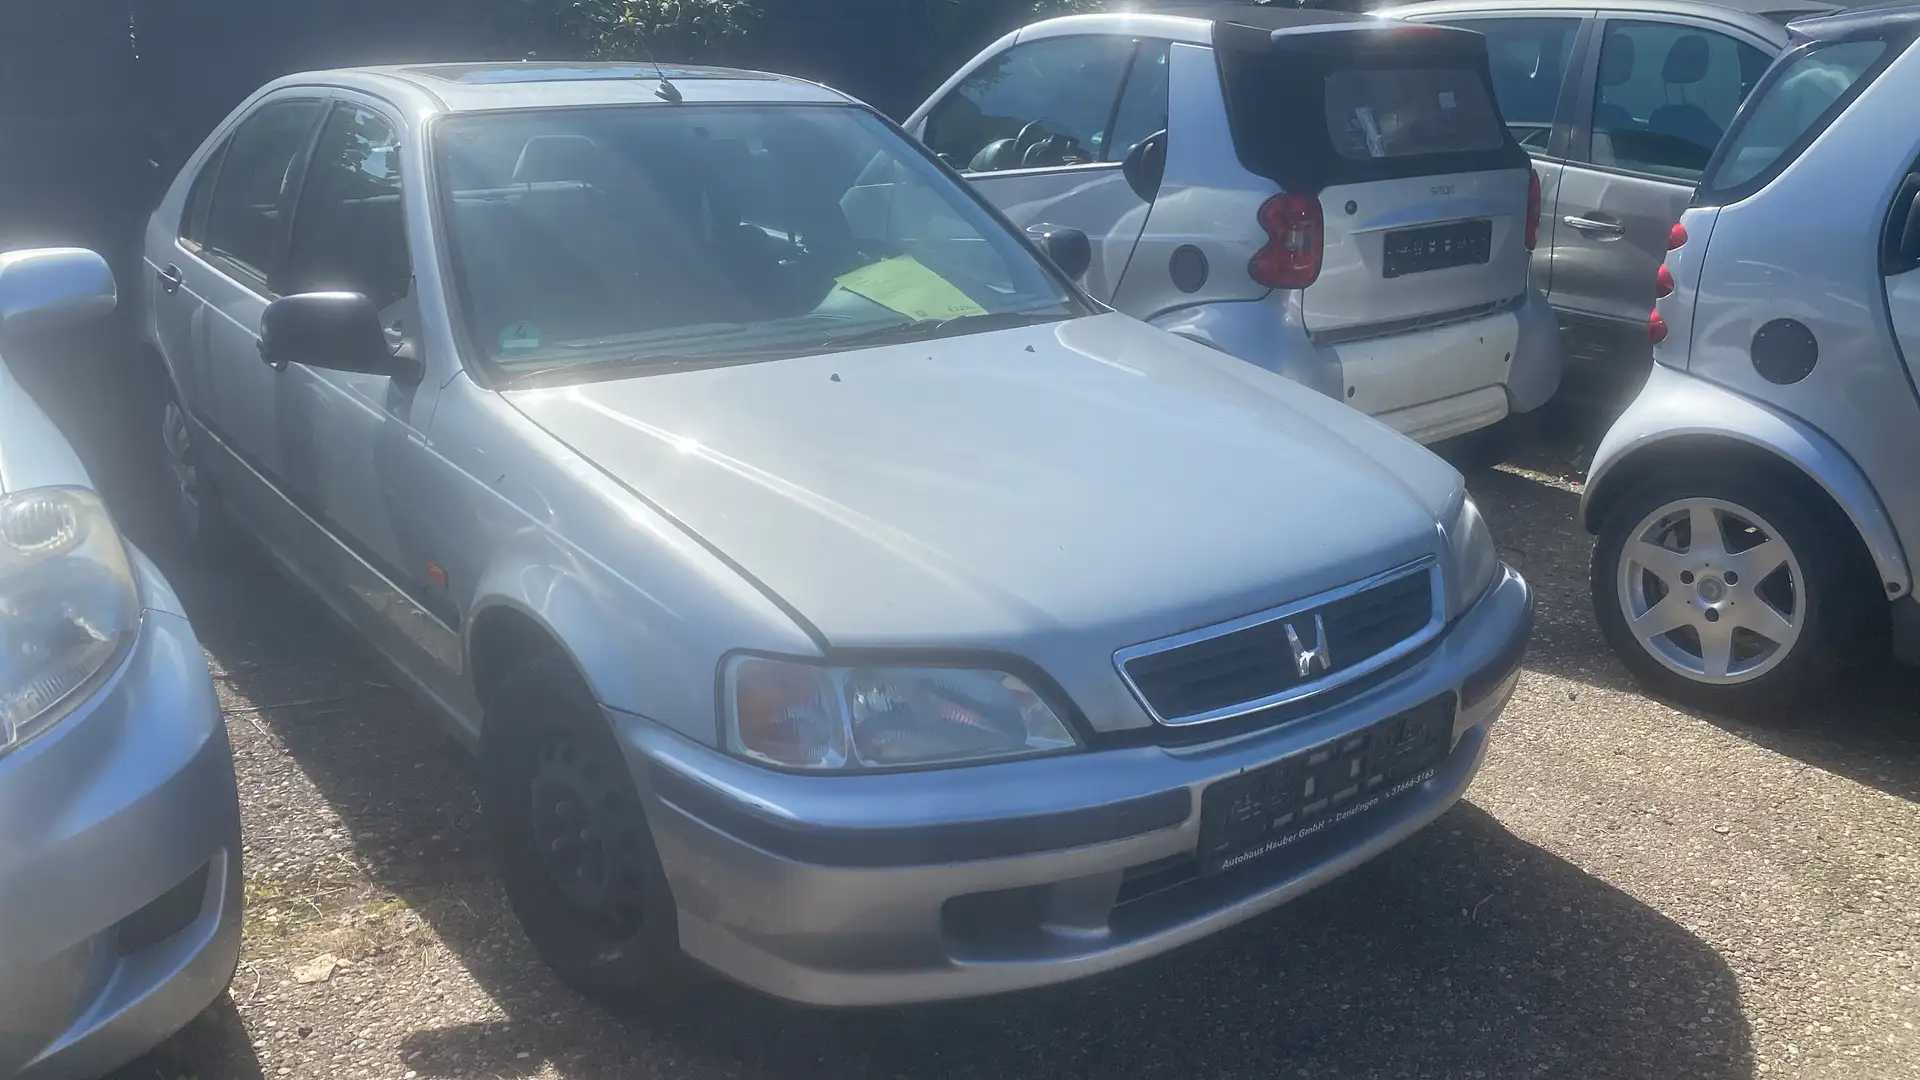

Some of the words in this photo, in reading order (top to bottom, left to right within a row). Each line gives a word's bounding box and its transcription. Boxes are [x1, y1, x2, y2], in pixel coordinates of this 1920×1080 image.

[1222, 847, 1264, 870] Autohaus
[1265, 833, 1297, 852] Hauber
[1298, 820, 1325, 838] GmbH
